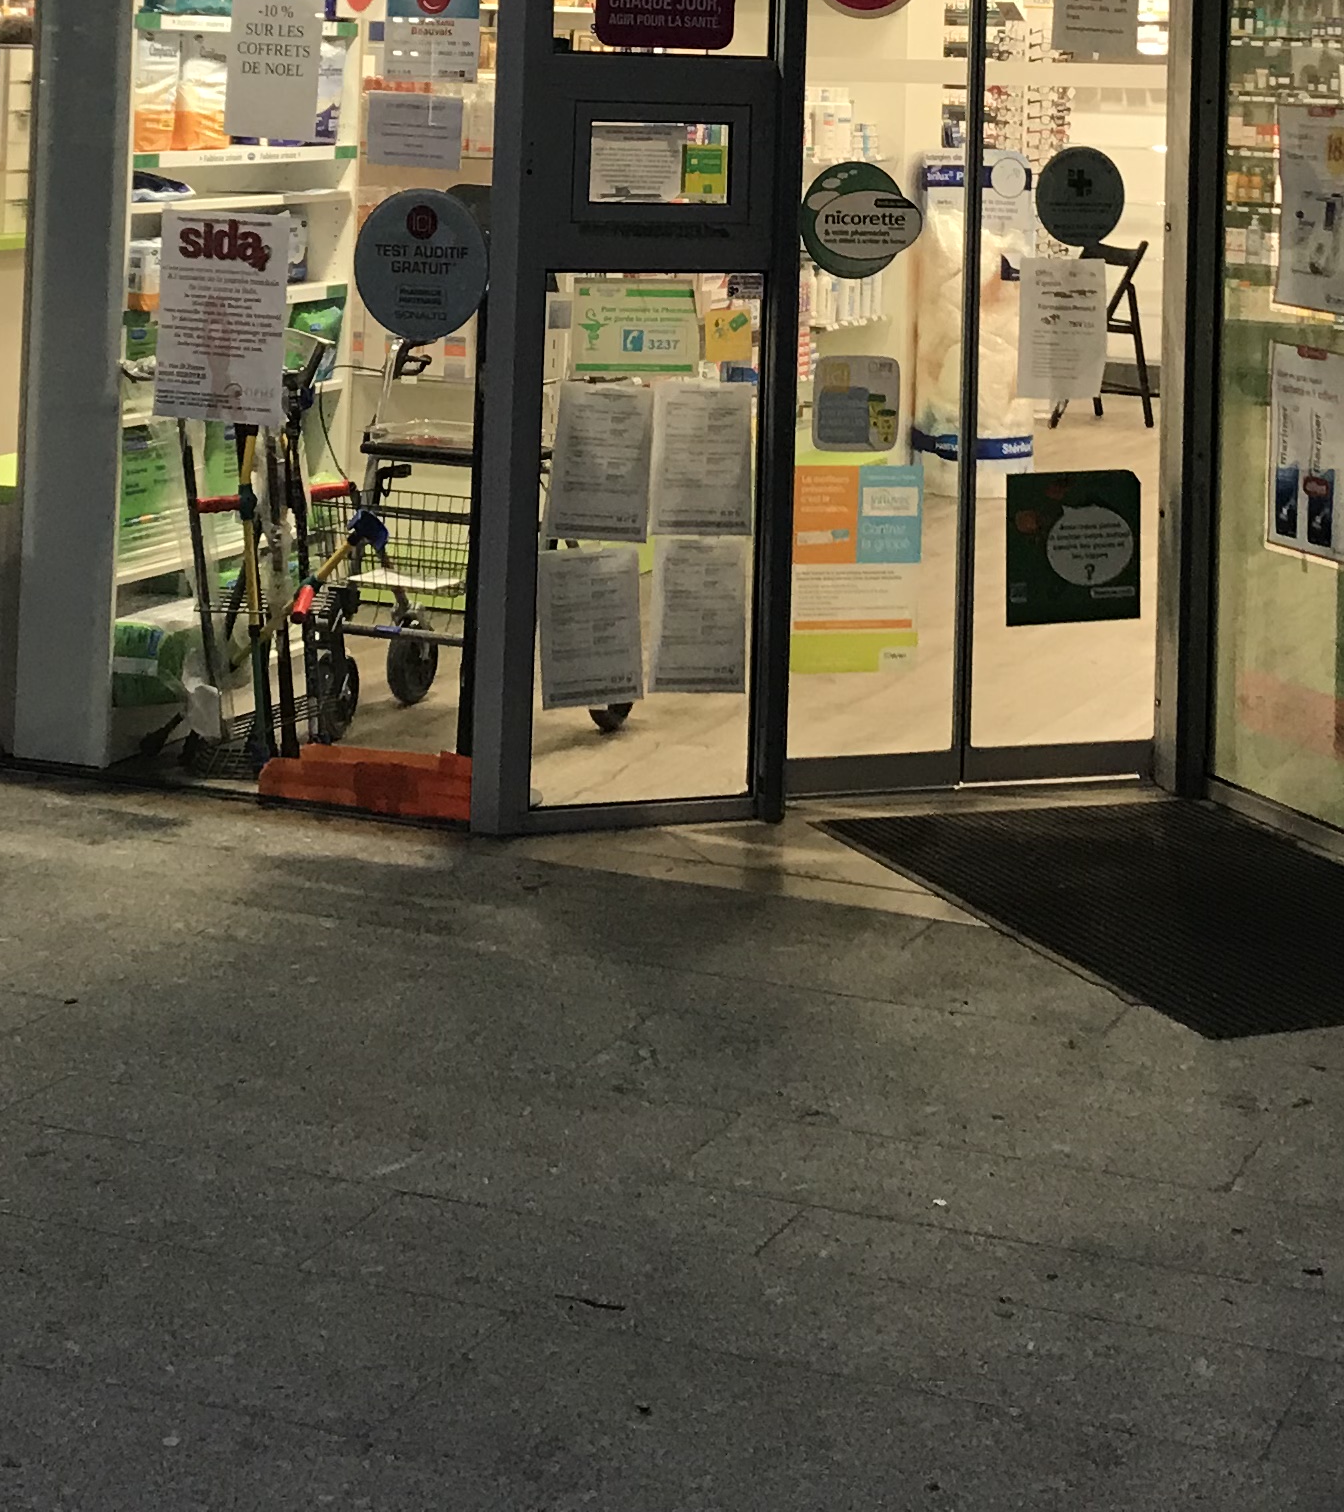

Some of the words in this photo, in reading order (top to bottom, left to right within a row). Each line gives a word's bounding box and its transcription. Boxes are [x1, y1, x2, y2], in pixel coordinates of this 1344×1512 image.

[258, 3, 277, 19] -10
[609, 13, 635, 26] AGIR
[637, 14, 665, 27] POUR
[668, 15, 682, 27] LA
[245, 22, 275, 38] SUR
[278, 23, 305, 39] LES
[236, 40, 312, 60] COFFRETS
[241, 60, 260, 76] DE
[264, 61, 305, 78] NOEL
[824, 210, 906, 226] nicorette
[179, 219, 263, 262] sida
[374, 243, 409, 258] TEST
[413, 245, 469, 260] AUDITIF
[646, 338, 681, 351] 3237
